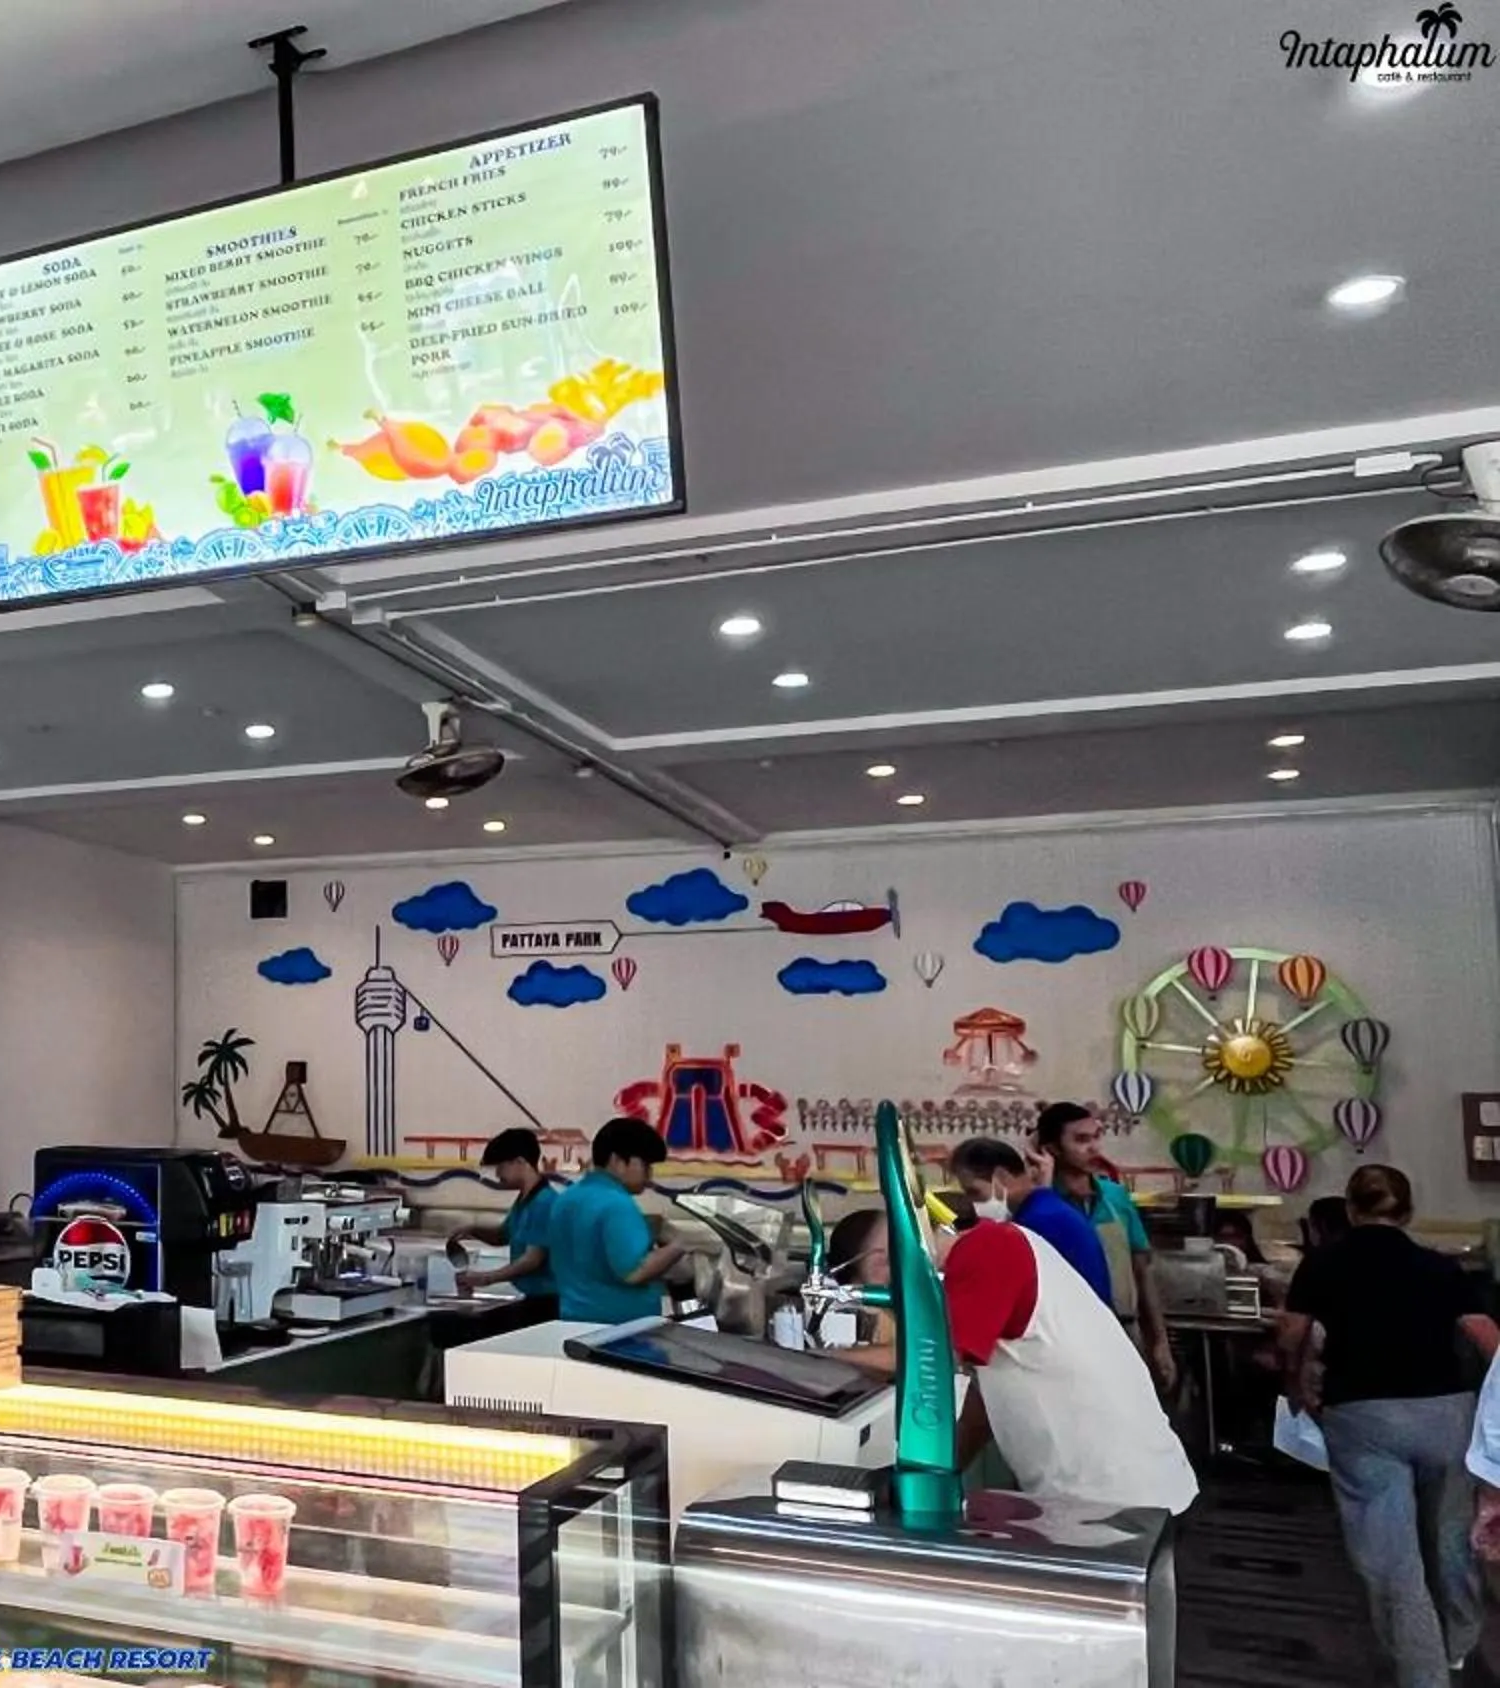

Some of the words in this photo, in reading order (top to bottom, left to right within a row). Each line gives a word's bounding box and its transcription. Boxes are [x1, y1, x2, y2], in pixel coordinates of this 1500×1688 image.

[469, 132, 572, 169] APPETIZER
[400, 177, 459, 200] FRENCH
[462, 165, 506, 188] FRIES
[401, 204, 468, 230] CHICKEN
[472, 192, 527, 214] STICKS
[206, 225, 297, 258] SMOOTHIES
[403, 236, 474, 259] NUGGETS
[42, 256, 82, 275] SODA
[165, 265, 207, 283] MIXED
[256, 237, 327, 260] SMOOTHIE
[405, 275, 435, 289] BBQ
[438, 258, 507, 283] CHICKEN
[511, 247, 563, 265] WINGS
[21, 277, 62, 294] LEMON
[65, 269, 97, 284] SODA
[166, 283, 255, 311] STRAWBERRY
[259, 266, 329, 289] SMOOTHIE
[50, 299, 82, 313] SODA
[407, 305, 441, 320] MINI
[445, 290, 503, 312] CHEESE
[506, 281, 546, 300] BALL
[168, 310, 259, 338] WATERMELON
[262, 294, 332, 318] SMOOTHIE
[26, 330, 58, 345] ROSE
[61, 323, 94, 337] SODA
[68, 349, 100, 363] SODA
[169, 343, 242, 367] PINEAPPLE
[245, 327, 315, 351] SMOOTHIE
[411, 350, 451, 366] PORK
[14, 388, 45, 402] SODA
[9, 418, 39, 431] SODA
[501, 932, 560, 948] PATTAYA
[565, 931, 602, 947] PARK
[59, 1250, 127, 1273] PEPSI
